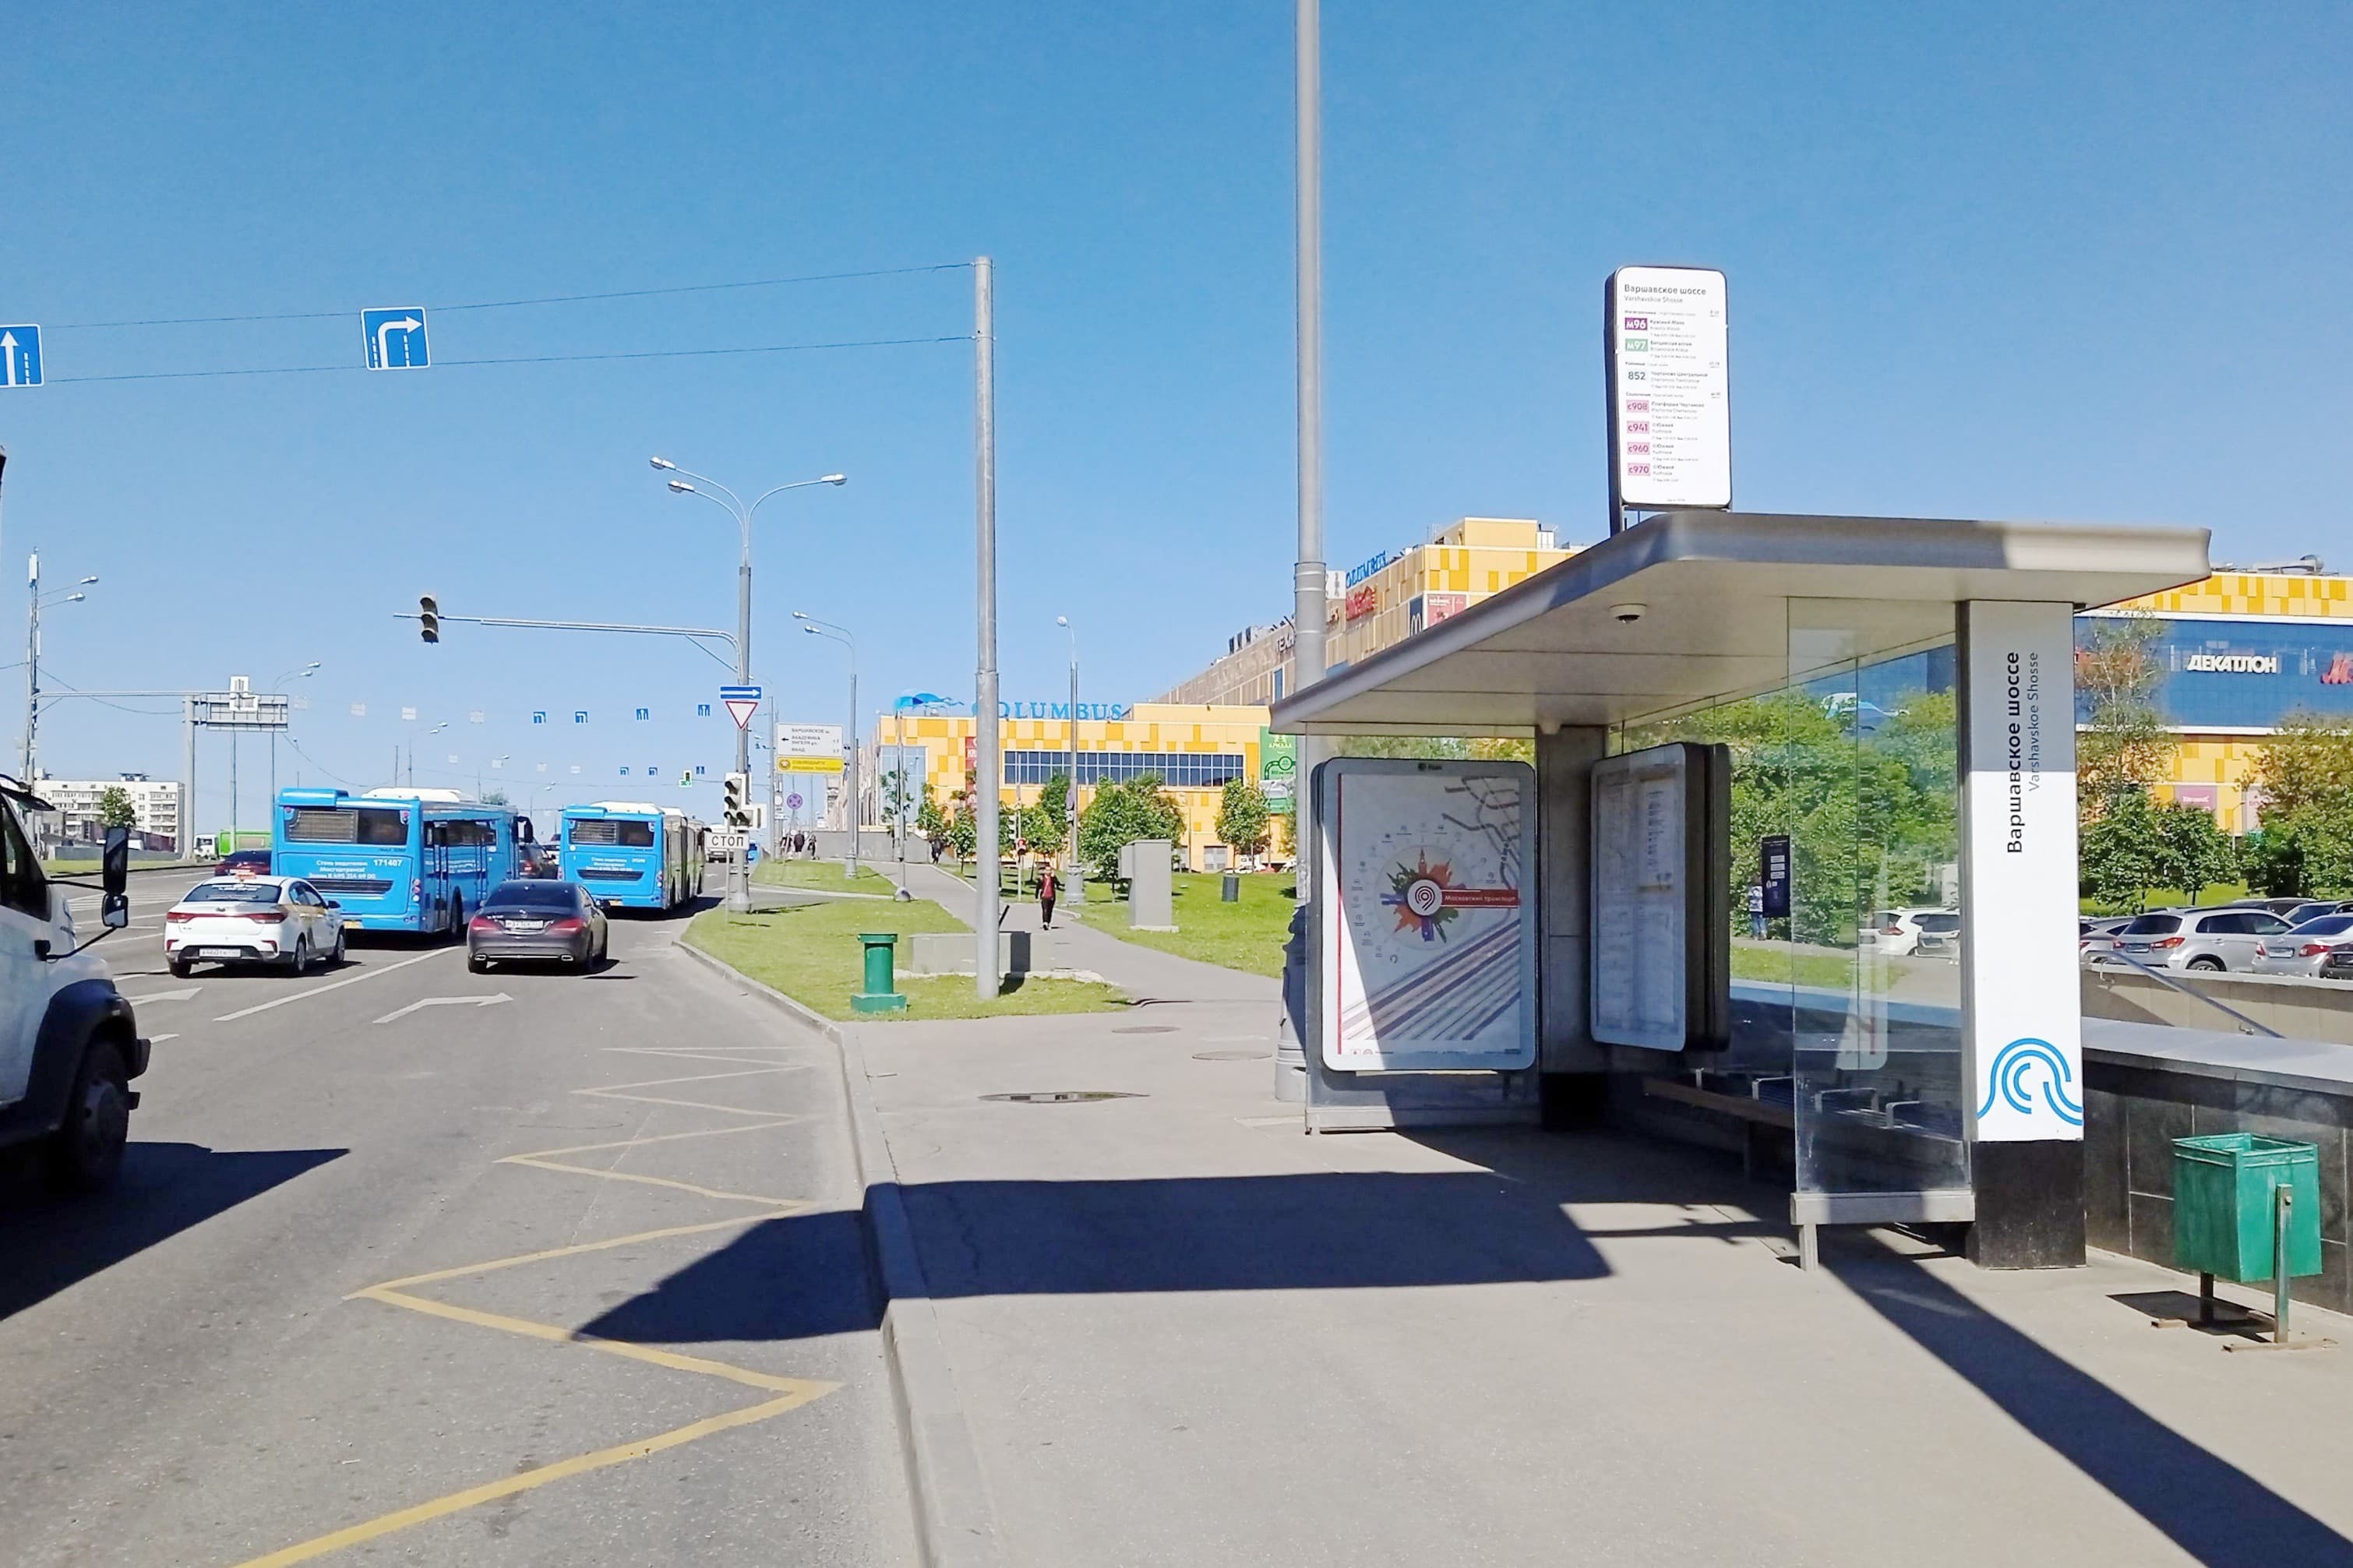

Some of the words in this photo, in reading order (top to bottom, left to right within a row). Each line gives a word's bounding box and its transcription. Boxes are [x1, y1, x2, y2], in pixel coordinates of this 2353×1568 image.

[1625, 284, 1678, 294] Варшавское
[1628, 371, 1646, 381] 852
[2186, 654, 2277, 674] ДЕКАТЛОН
[2007, 651, 2021, 717] шоссе
[2027, 652, 2039, 701] Shosse
[2028, 704, 2041, 791] Varshavskoe
[2007, 722, 2026, 854] Варшавское
[711, 835, 744, 847] СТОП
[374, 858, 403, 867] 171407
